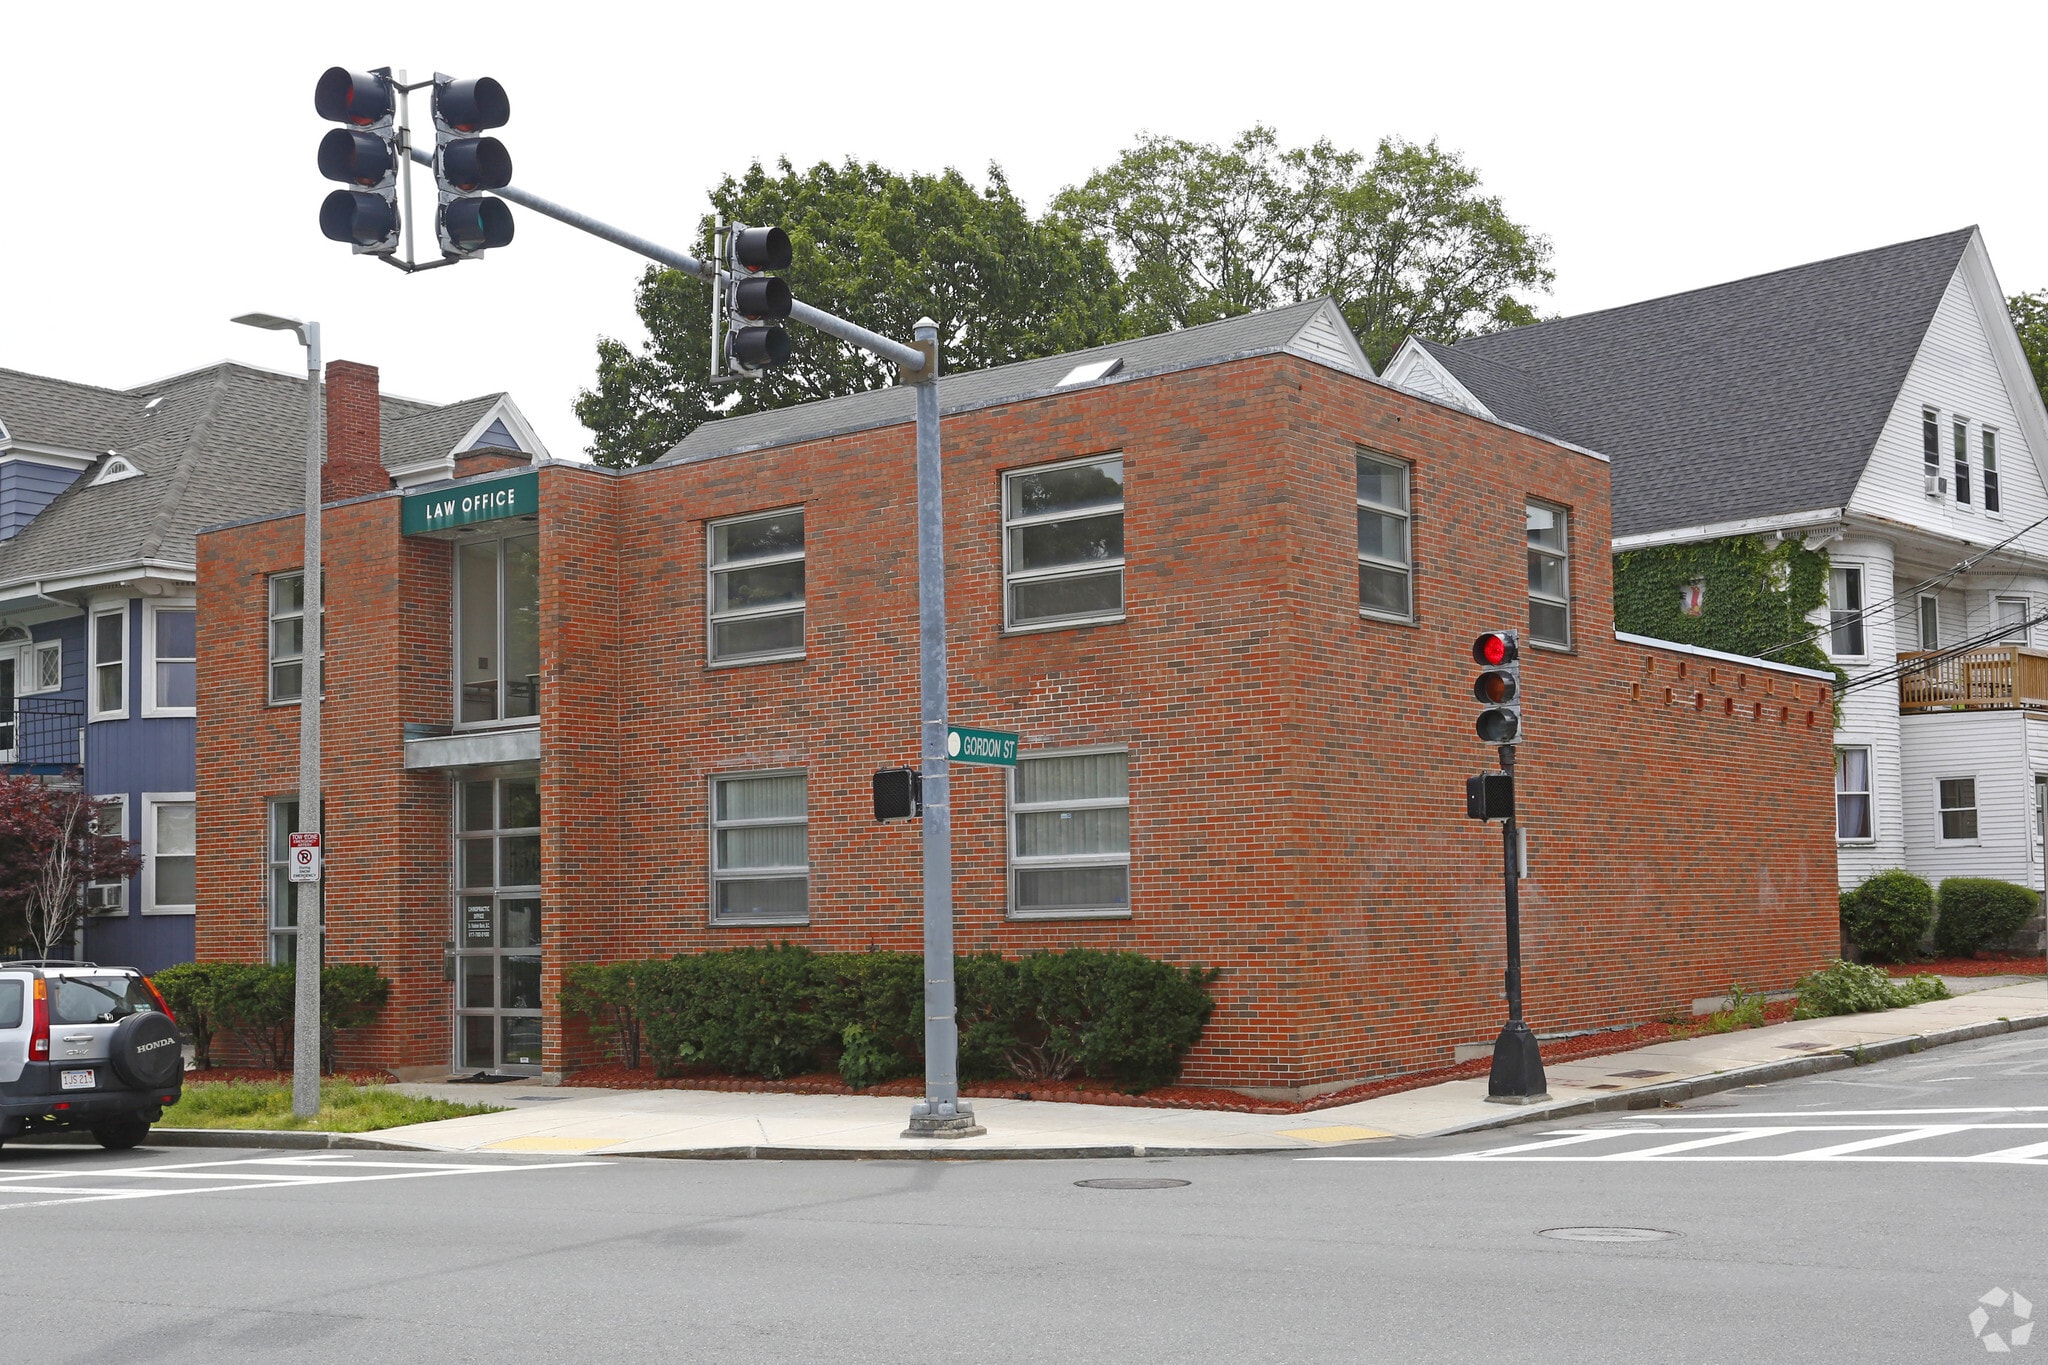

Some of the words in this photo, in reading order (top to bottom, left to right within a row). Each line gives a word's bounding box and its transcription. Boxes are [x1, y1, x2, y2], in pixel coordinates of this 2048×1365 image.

[426, 500, 456, 519] LAW
[462, 488, 515, 512] OFFICE
[963, 736, 1001, 757] GORDON
[1003, 740, 1015, 759] ST
[137, 1037, 176, 1054] HONDA
